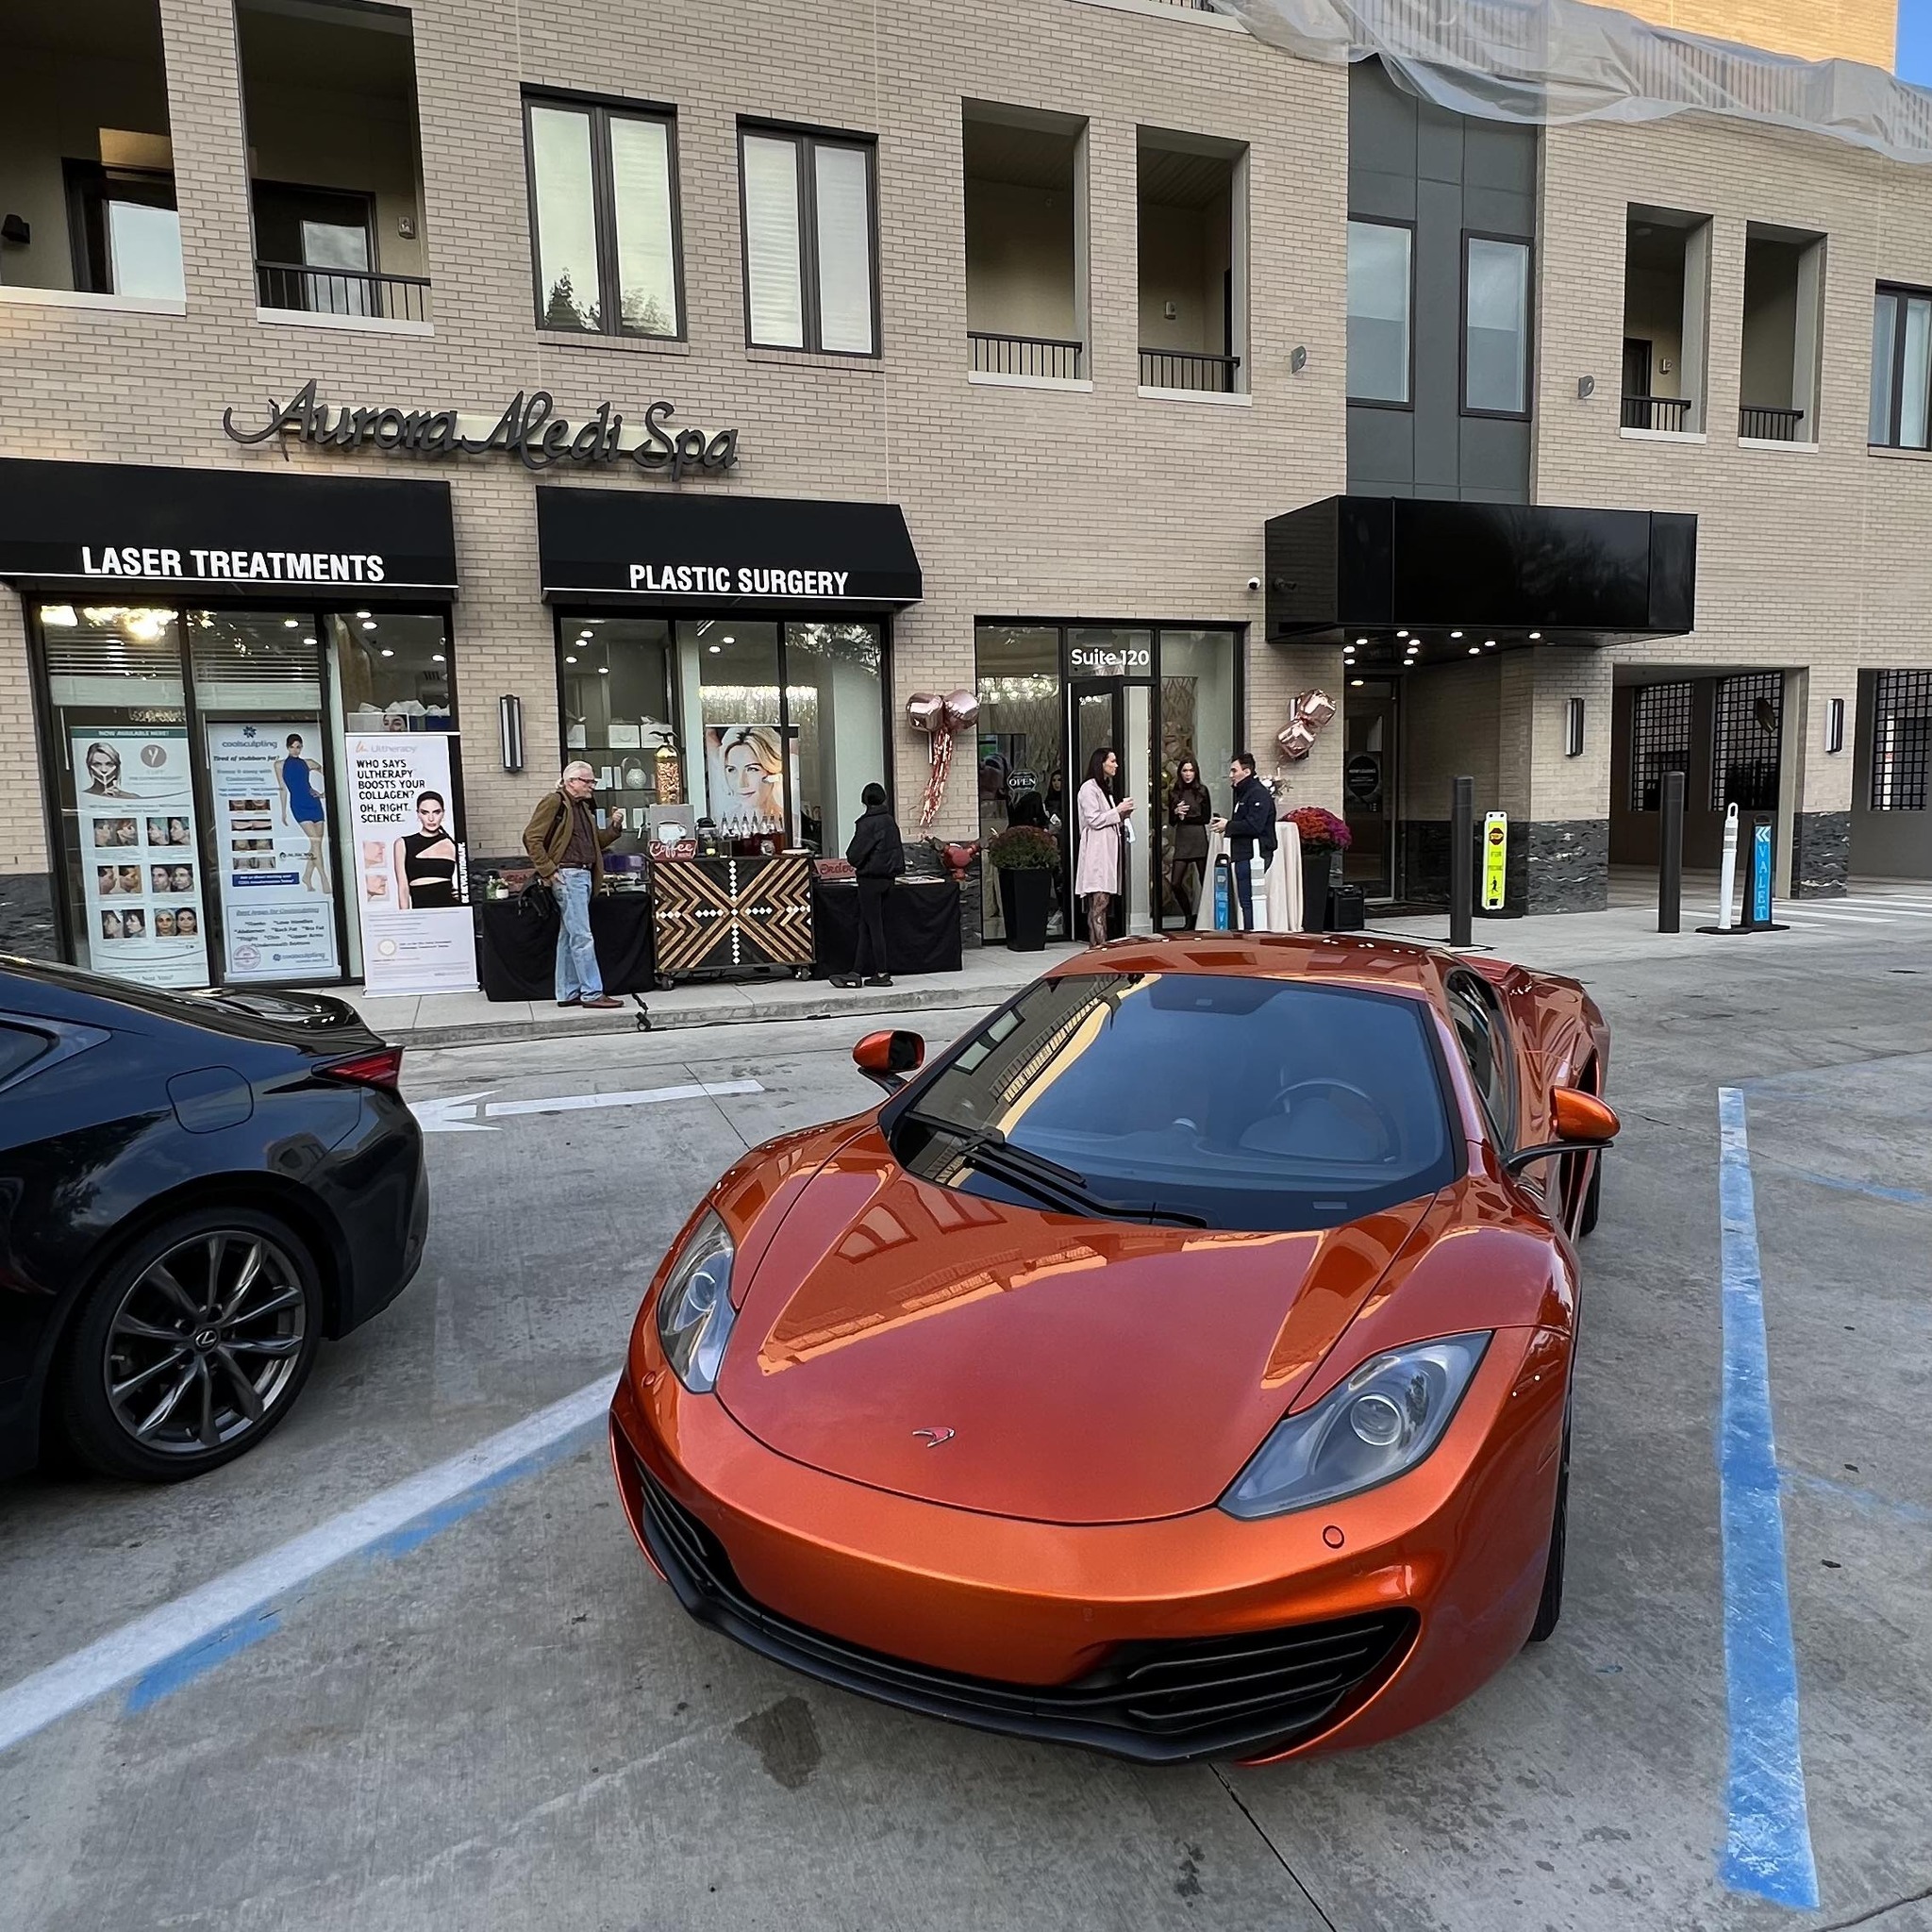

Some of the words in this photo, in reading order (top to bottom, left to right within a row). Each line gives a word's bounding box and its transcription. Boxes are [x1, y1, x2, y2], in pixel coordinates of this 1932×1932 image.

[224, 378, 458, 453] Aurora
[461, 391, 623, 470] Medi
[632, 401, 739, 482] Spa
[81, 546, 183, 576] LASER
[190, 549, 385, 582] TREATMENTS
[629, 564, 731, 591] PLASTIC
[738, 567, 849, 595] SURGERY
[1071, 648, 1117, 666] Suite
[1119, 649, 1150, 666] 120
[371, 745, 417, 754] Ultherapy
[357, 759, 379, 768] WHO
[382, 759, 407, 768] SAYS
[358, 770, 413, 779] ULTHERAPY
[358, 780, 396, 790] BOOSTS
[399, 780, 425, 789] YOUR
[1009, 778, 1036, 787] OPEN
[359, 791, 414, 800] COLLAGEN?
[360, 804, 376, 813] OH,
[380, 803, 411, 812] RIGHT.
[361, 814, 406, 824] SCIENCE.
[650, 841, 694, 858] Coffee
[1757, 845, 1768, 920] VALET
